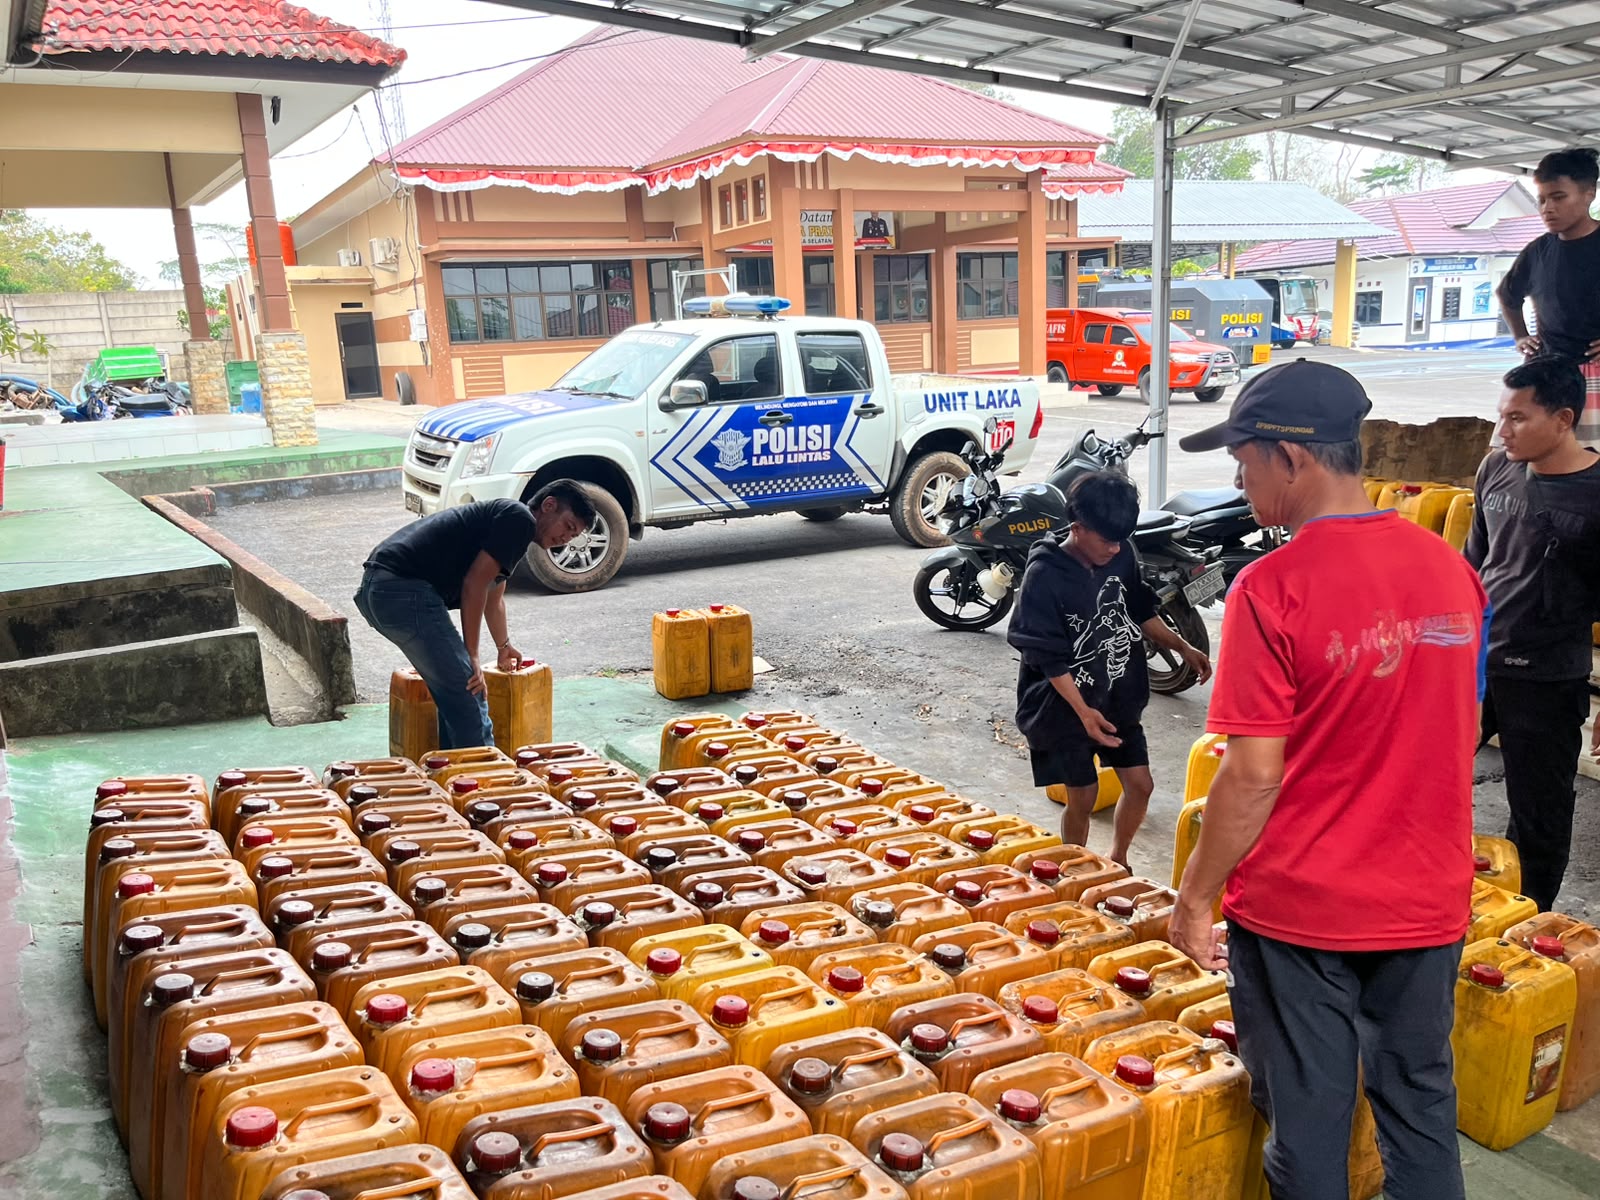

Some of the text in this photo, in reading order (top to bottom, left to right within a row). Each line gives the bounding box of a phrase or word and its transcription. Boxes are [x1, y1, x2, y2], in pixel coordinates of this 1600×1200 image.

[800, 211, 832, 222] Datan
[1221, 313, 1263, 325] POLISI
[1046, 323, 1066, 334] AFIS
[924, 388, 1022, 414] UNIT LAKA
[753, 424, 831, 455] POLISI
[752, 451, 831, 466] LALU LINTAS
[1008, 518, 1051, 534] POLISI
